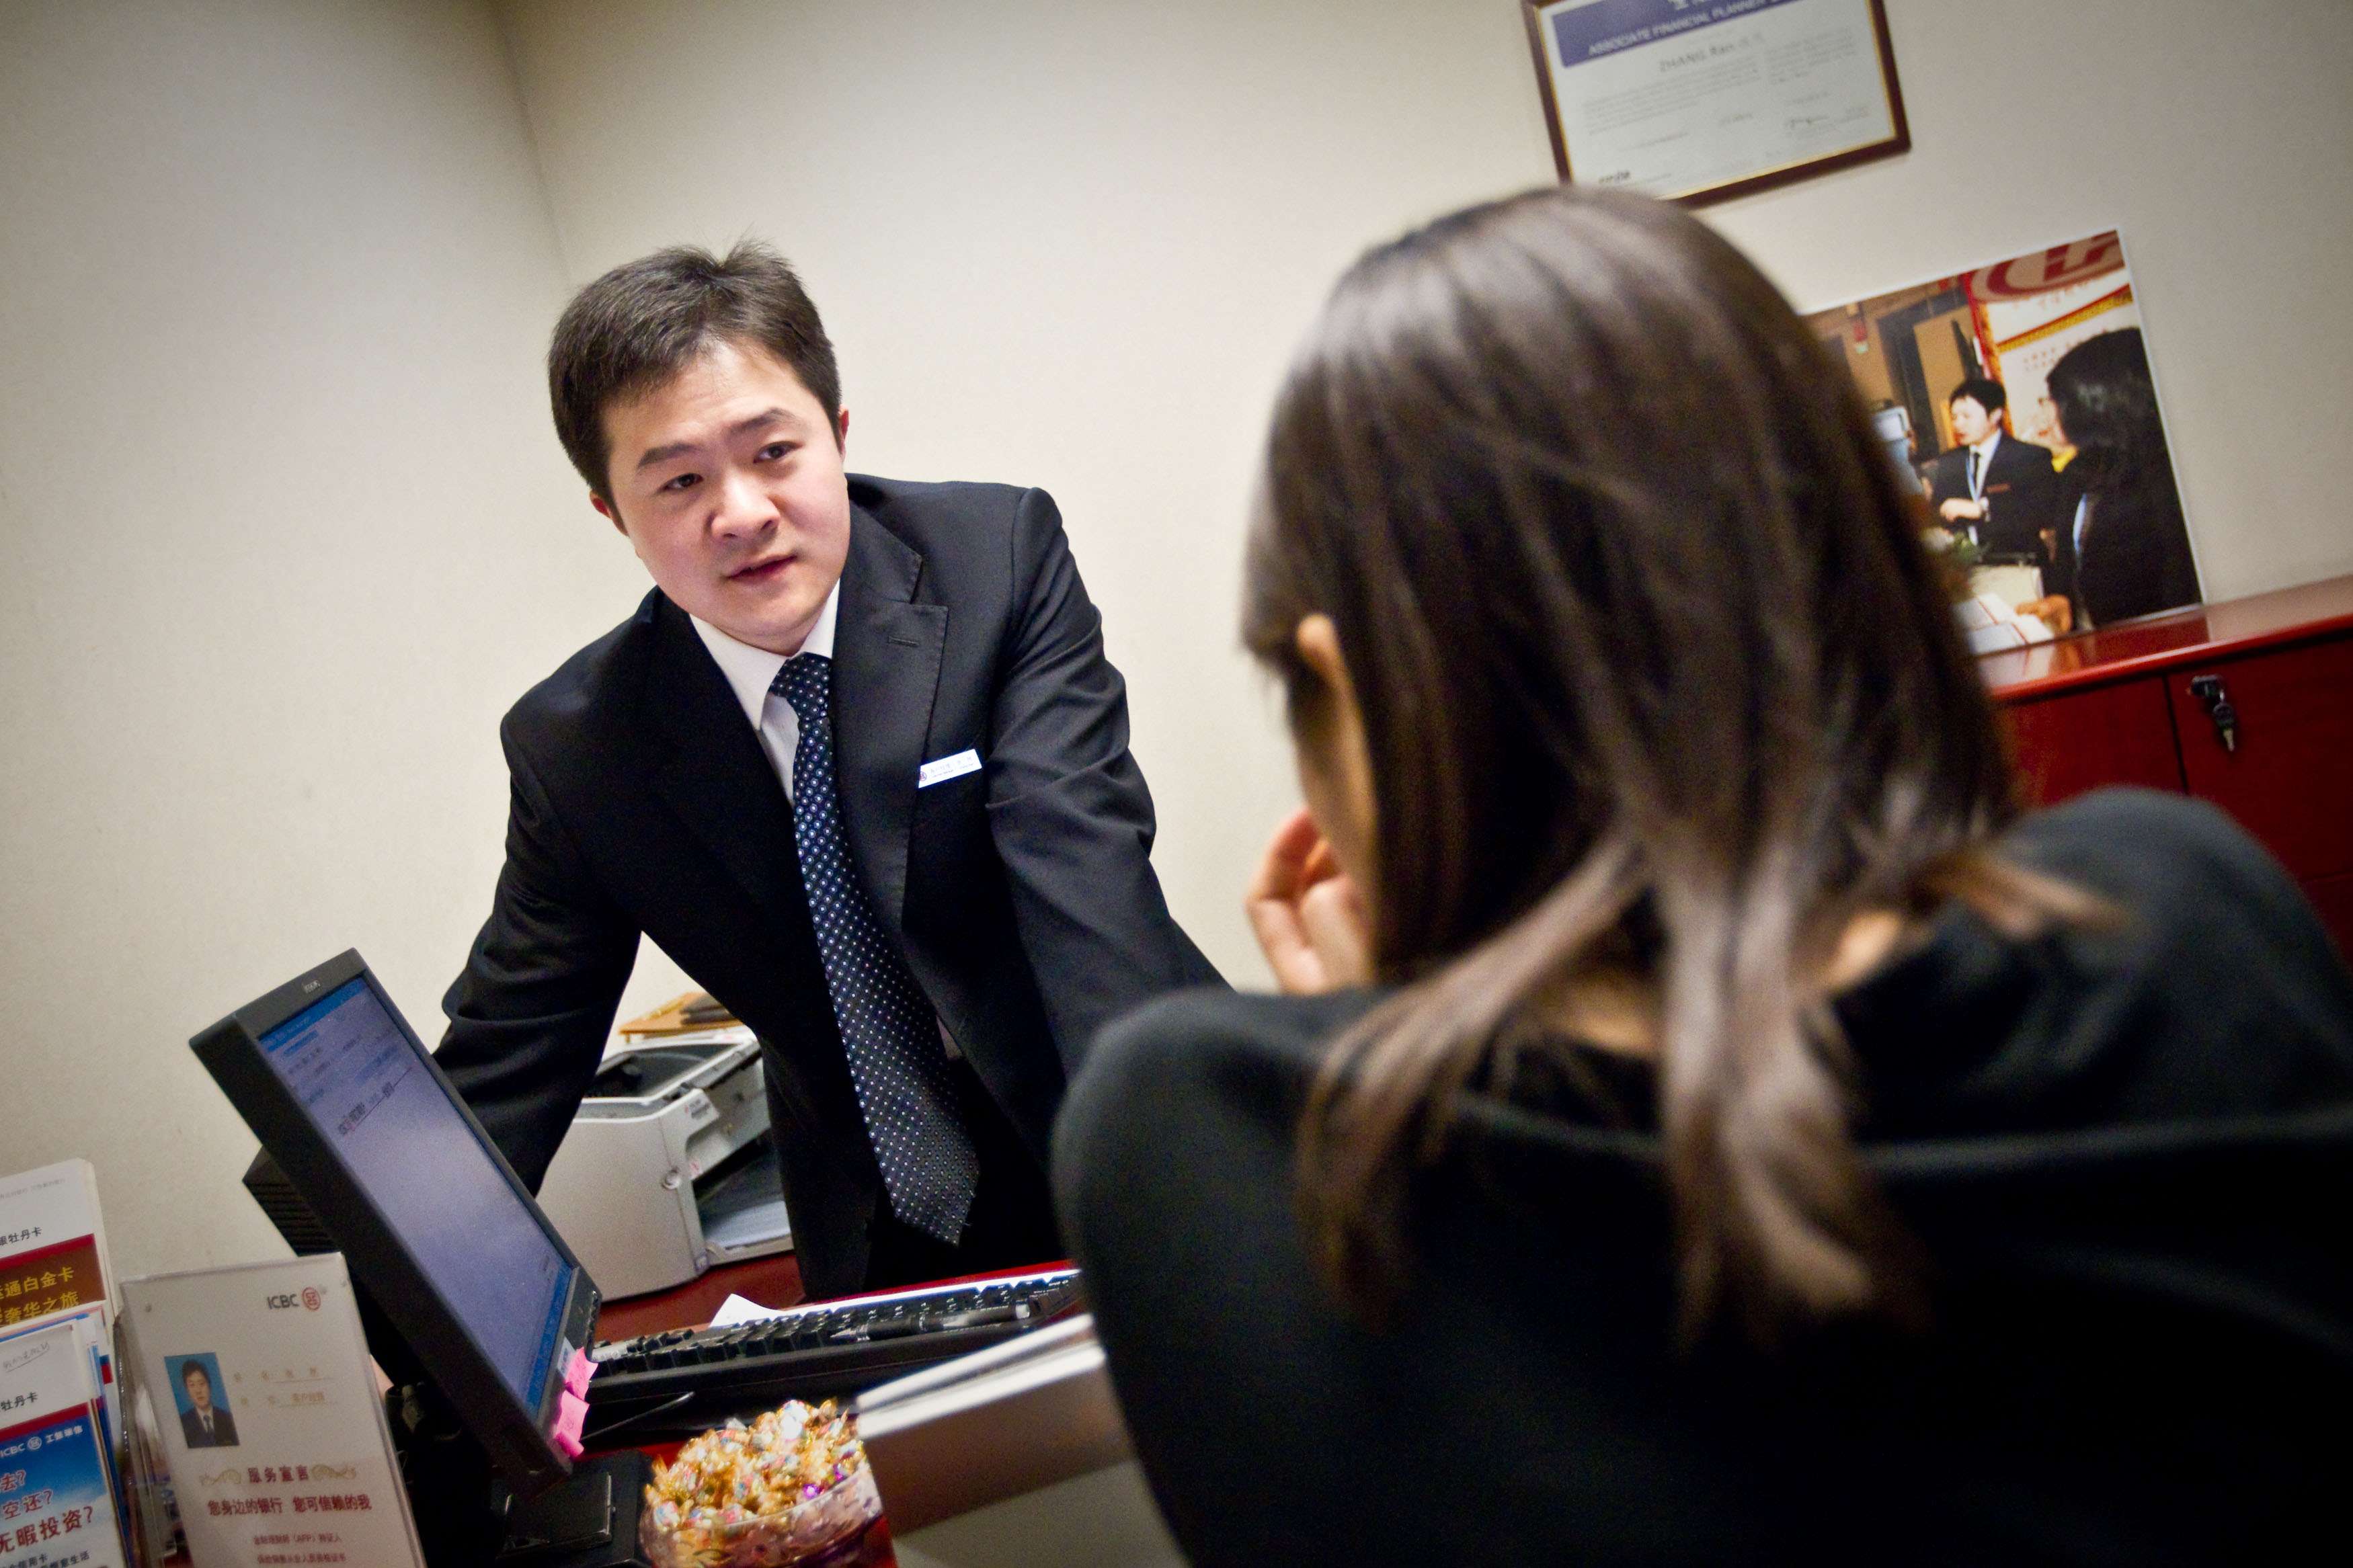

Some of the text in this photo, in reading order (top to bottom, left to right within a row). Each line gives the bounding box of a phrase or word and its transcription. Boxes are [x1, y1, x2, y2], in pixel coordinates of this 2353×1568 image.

[1589, 28, 1650, 55] ASSOCIATE
[1652, 12, 1710, 35] FINANCIAL
[0, 1290, 80, 1327] 奢华之旅
[267, 1293, 299, 1309] ICBC
[0, 1442, 26, 1457] ICBC
[247, 1464, 309, 1483] 服务宣言
[207, 1493, 372, 1516] 您身边的银行 您可信赖的我
